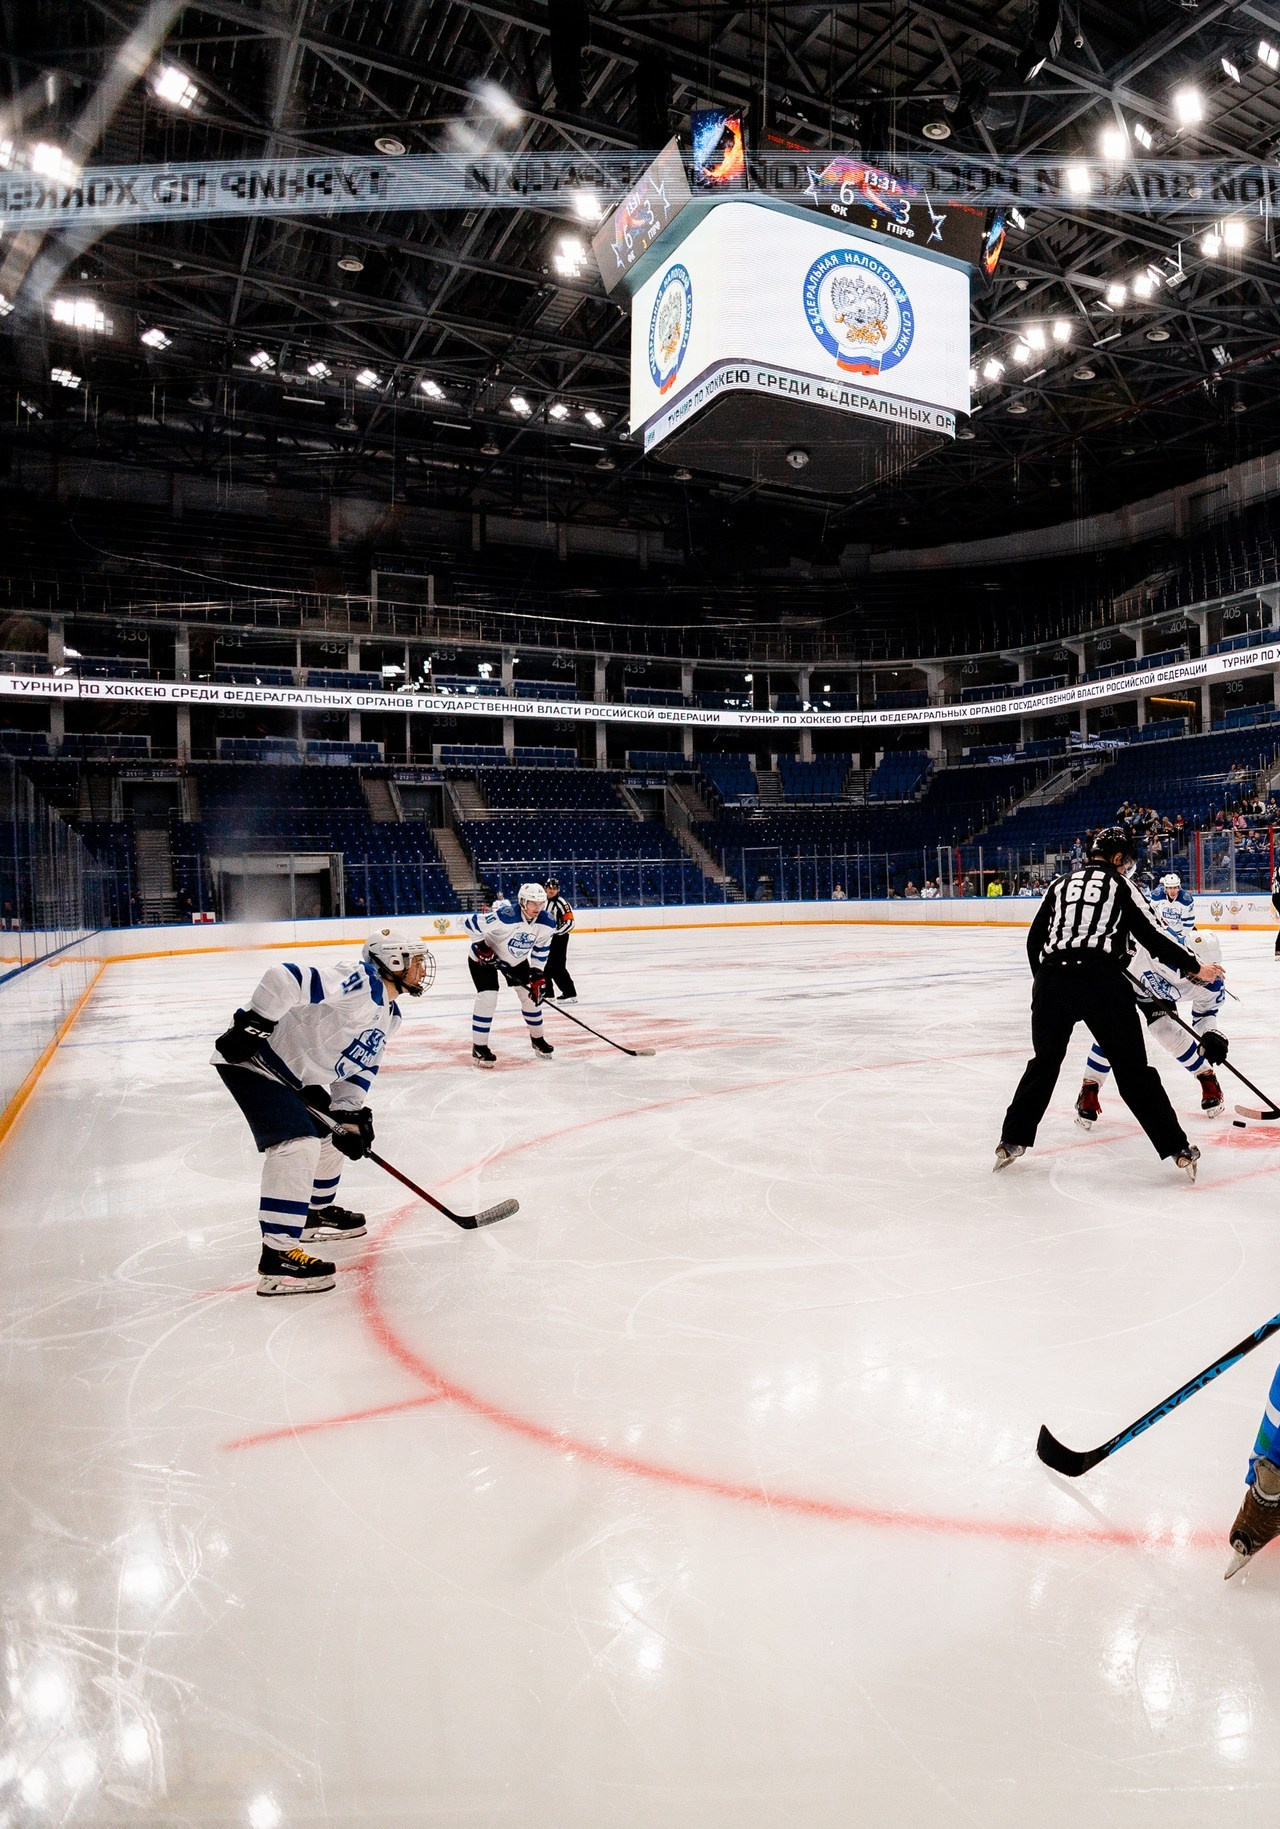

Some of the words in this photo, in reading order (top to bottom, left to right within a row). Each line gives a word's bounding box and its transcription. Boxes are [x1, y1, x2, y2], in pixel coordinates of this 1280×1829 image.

[839, 181, 855, 205] 6
[643, 199, 654, 225] 3
[830, 203, 848, 217] ФК
[895, 199, 911, 224] 3
[869, 218, 877, 229] 3
[886, 221, 914, 238] ГПРФ
[623, 224, 633, 249] 6
[806, 254, 839, 334] ФЕДЕРАЛЬНАЯ
[844, 252, 907, 303] НАЛОГОВАЯ
[891, 311, 912, 357] СЛУЖБА
[694, 389, 704, 407] ПО
[705, 370, 750, 398] ХОККЕЮ
[757, 372, 811, 396] СРЕДИ
[816, 386, 931, 425] ФЕДЕРАЛЬНЫХ
[1222, 607, 1241, 620] 405
[117, 629, 148, 642] 430
[215, 635, 244, 648] 431
[319, 642, 347, 655] 432
[1096, 640, 1112, 651] 403
[431, 650, 457, 662] 433
[1053, 651, 1070, 662] 402
[1222, 652, 1259, 669] ТУРНИР
[1260, 649, 1275, 661] ПО
[551, 658, 575, 670] 434
[624, 662, 646, 675] 435
[961, 664, 980, 675] 401
[738, 714, 780, 724] ТУРНИР
[783, 715, 797, 724] ПО
[800, 715, 842, 724] ХОККЕЮ
[844, 714, 877, 724] СРЕДИ
[969, 703, 1007, 716] ОРГАНОВ
[1008, 689, 1076, 712] ГОСУДАРСТВЕННОЙ
[1077, 683, 1105, 699] ВЛАСТИ
[1106, 672, 1155, 695] РОССИЙСКОЙ
[1156, 663, 1208, 683] ФЕДЕРАЦИИ
[1225, 679, 1244, 695] 305
[10, 680, 74, 693] ТУРНИР
[79, 683, 100, 695] ПО
[105, 684, 167, 697] ХОККЕЮ
[172, 687, 220, 701] СРЕДИ
[357, 695, 414, 708] ОРГАНОВ
[418, 699, 534, 714] ГОСУДАРСТВЕННОЙ
[537, 706, 582, 716] ВЛАСТИ
[584, 707, 655, 720] РОССИЙСКОЙ
[658, 710, 721, 723] ФЕДЕРАЦИИ
[119, 703, 151, 716] 335
[217, 707, 246, 720] 336
[1099, 706, 1114, 718] 303
[322, 711, 349, 723] 337
[432, 715, 457, 728] 338
[1054, 713, 1070, 725] 302
[553, 721, 577, 733] 339
[962, 725, 981, 736] 301
[1065, 879, 1102, 903] 66
